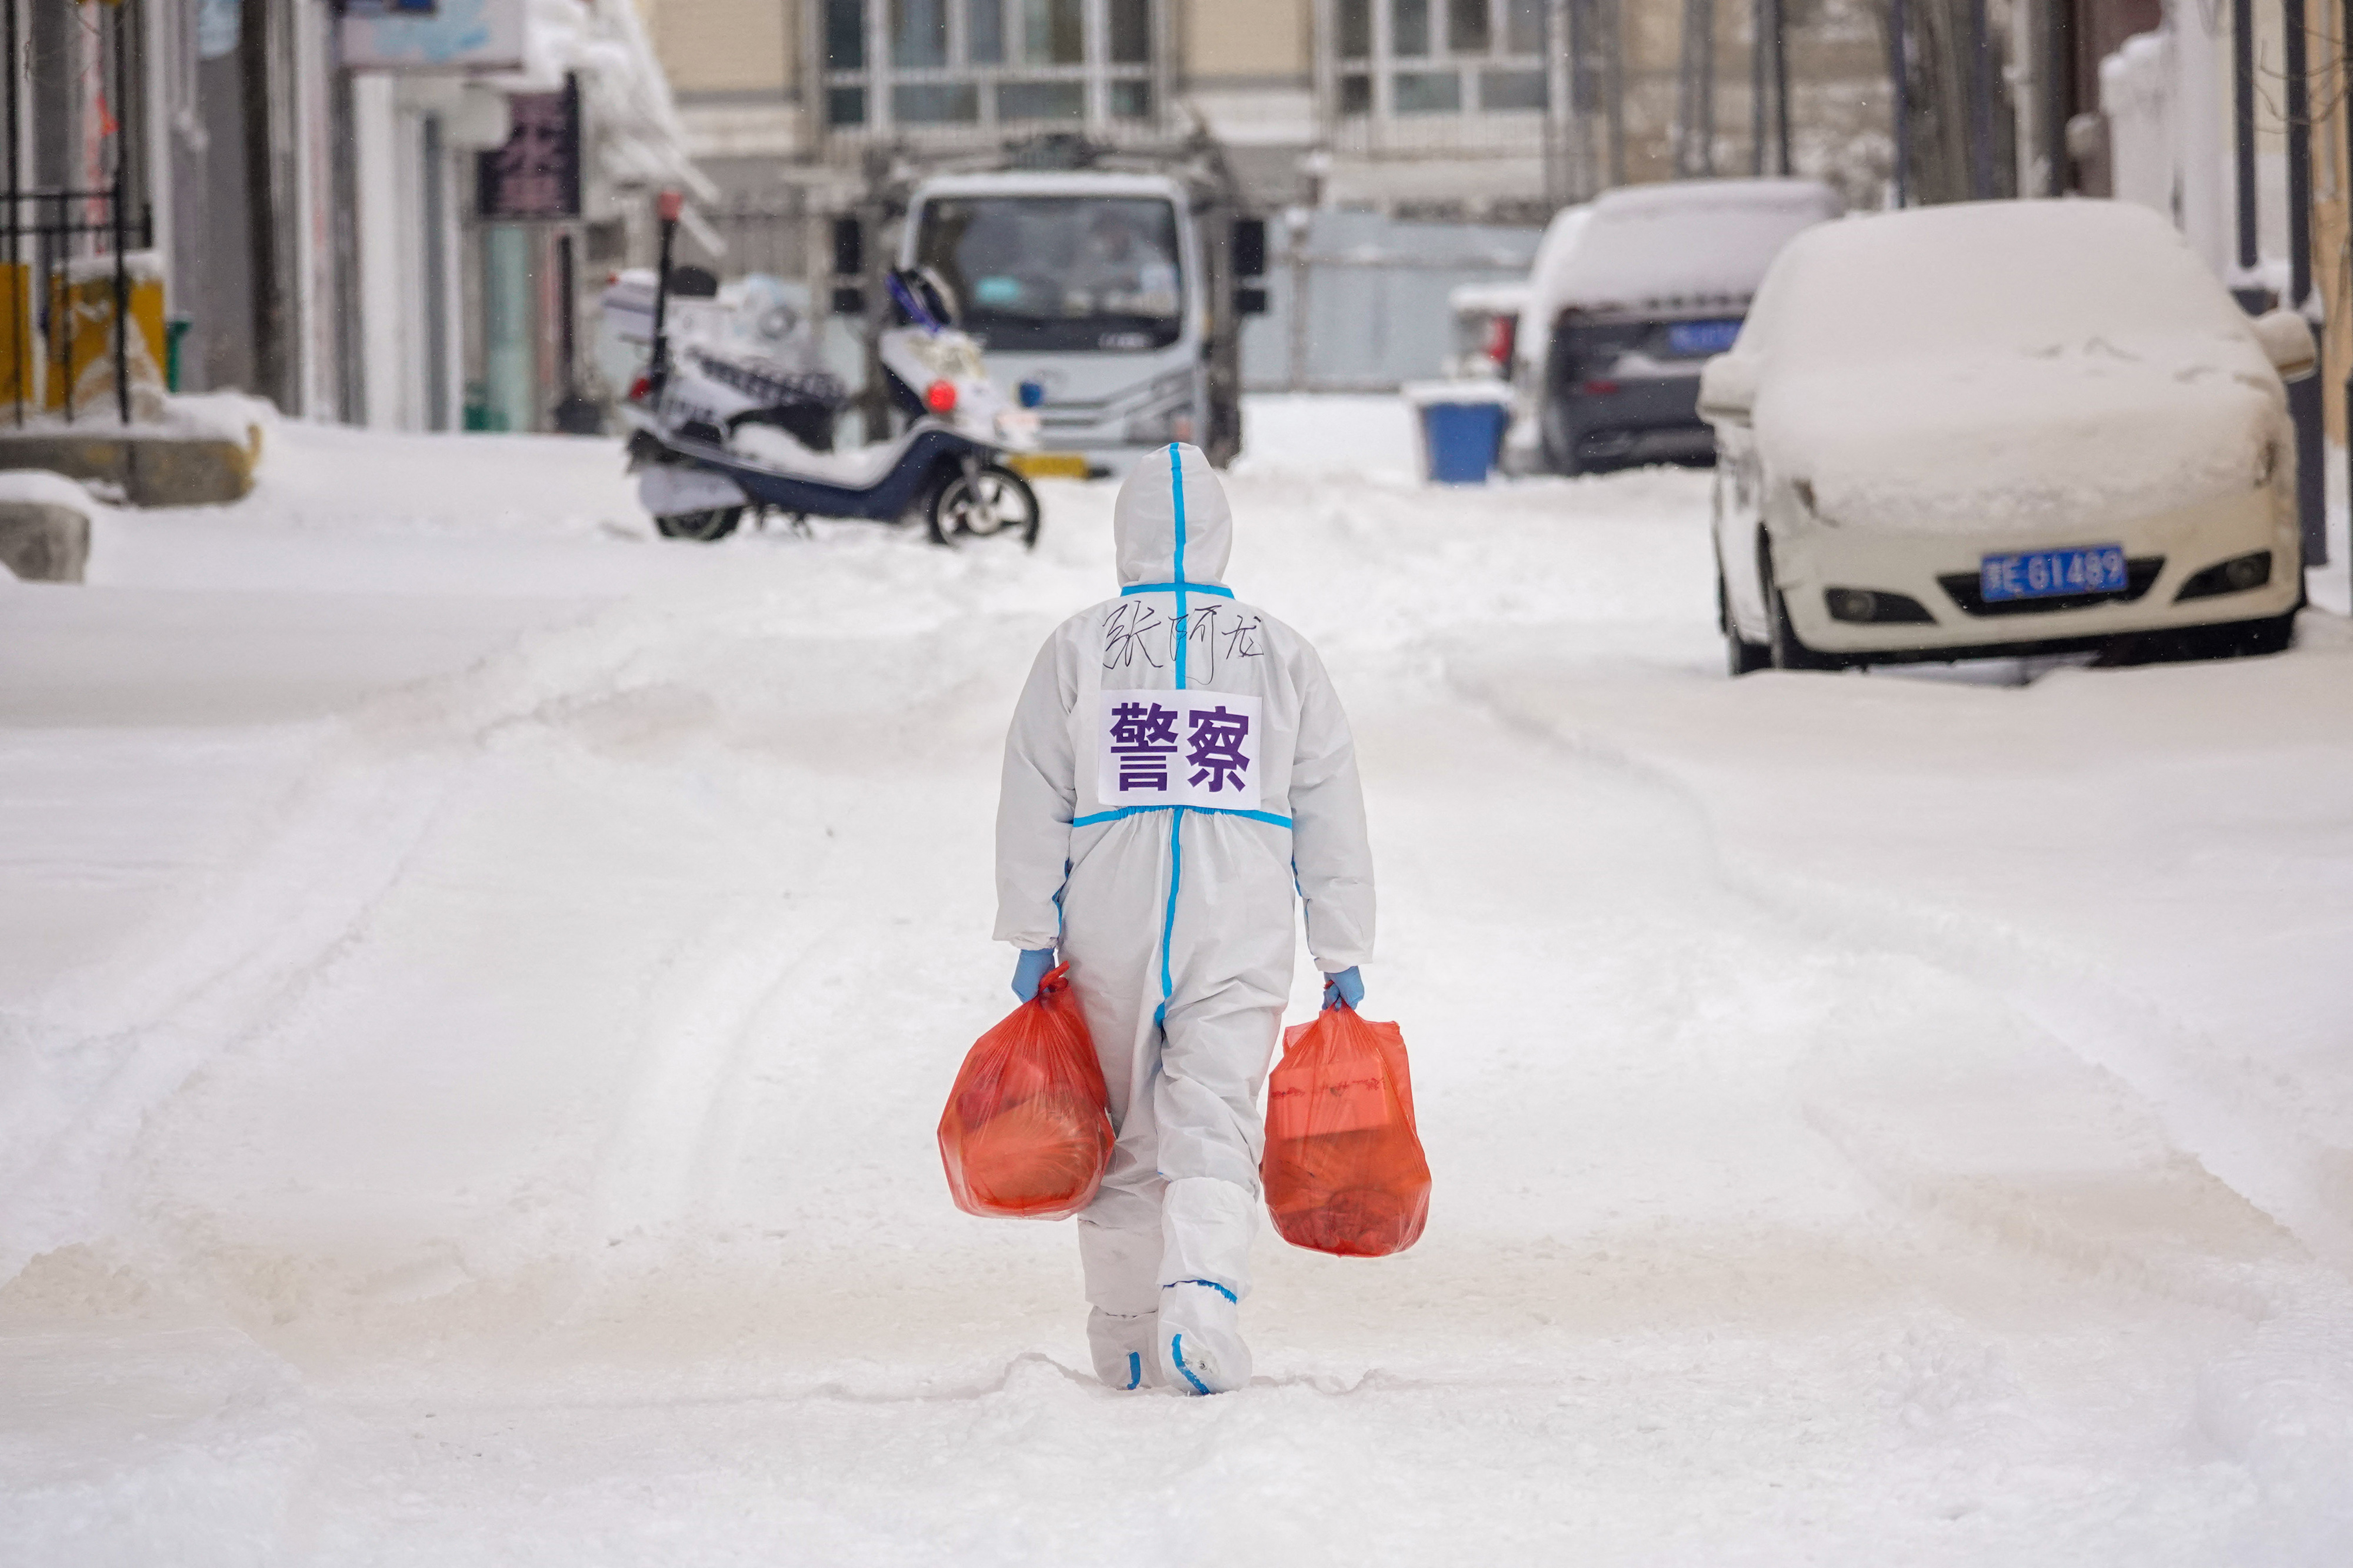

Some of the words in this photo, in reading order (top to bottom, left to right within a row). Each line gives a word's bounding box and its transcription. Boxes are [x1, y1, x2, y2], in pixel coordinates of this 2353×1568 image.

[1102, 600, 1264, 685] 张阿龙
[1109, 702, 1251, 792] 警察
